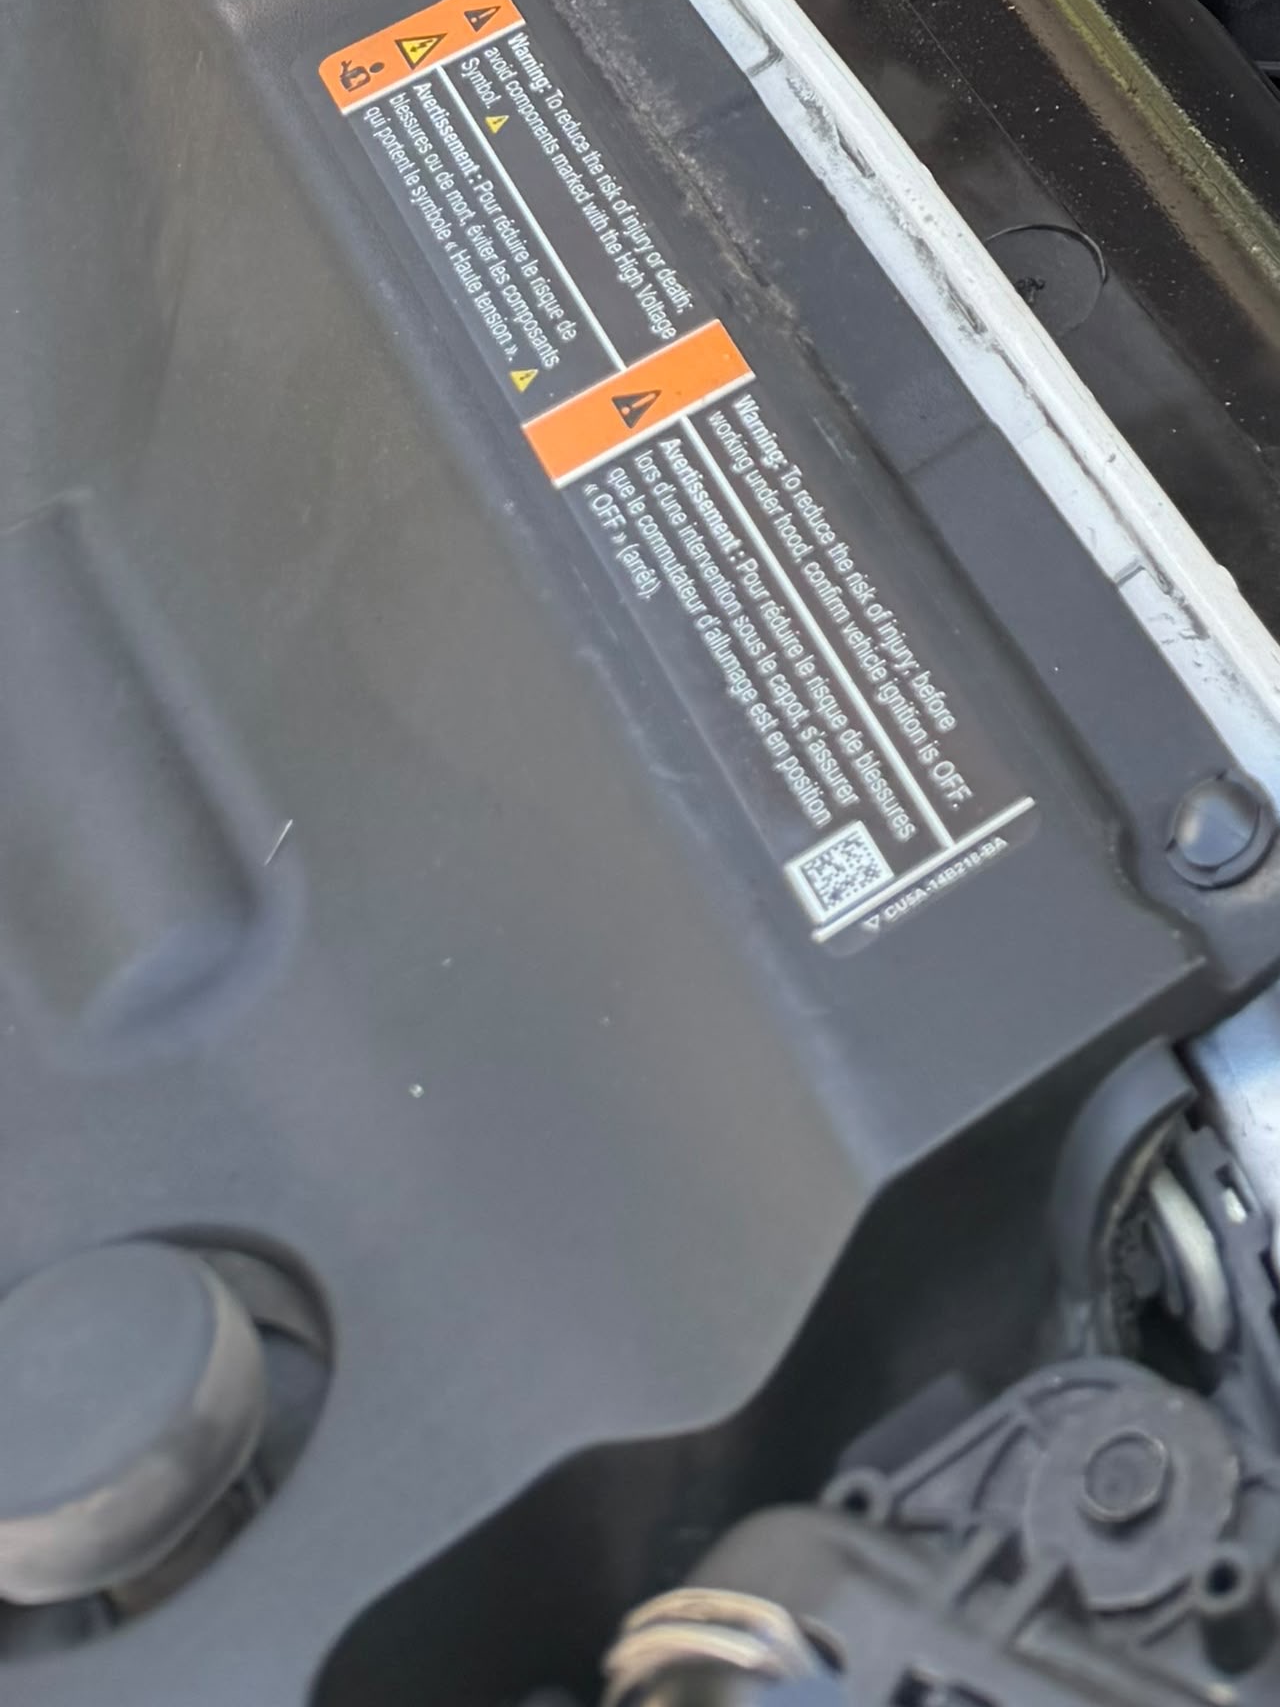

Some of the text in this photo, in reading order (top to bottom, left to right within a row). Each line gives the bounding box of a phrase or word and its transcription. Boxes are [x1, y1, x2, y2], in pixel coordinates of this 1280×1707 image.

[461, 57, 502, 109] Symbol.
[483, 47, 677, 340] avoid components marked with the High Voltage
[507, 32, 693, 314] Warning: To reduce the risk of injury or death;
[363, 106, 512, 346] qui portent le symbole Haute tension
[389, 92, 560, 369] blessures ou de mort, éviter les composants
[412, 82, 577, 341] Avertissement Pour réduire le risque de
[590, 493, 661, 599] OFF (arrêt).
[607, 467, 636, 499] que
[626, 494, 646, 515] le
[634, 449, 661, 484] lors
[678, 522, 742, 616] intervention
[732, 615, 766, 657] sous
[756, 652, 777, 674] le
[767, 673, 810, 729] capot,
[635, 514, 707, 615] commutateur
[732, 394, 956, 732] Warning: To reduce the risk of injury; before
[658, 438, 916, 841] Avertissement Pour réduire le risque de blessures
[707, 410, 972, 808] working under hood, confirm vehicle ignition is OFF.
[747, 703, 779, 735] est
[764, 731, 790, 757] en
[774, 755, 832, 826] position
